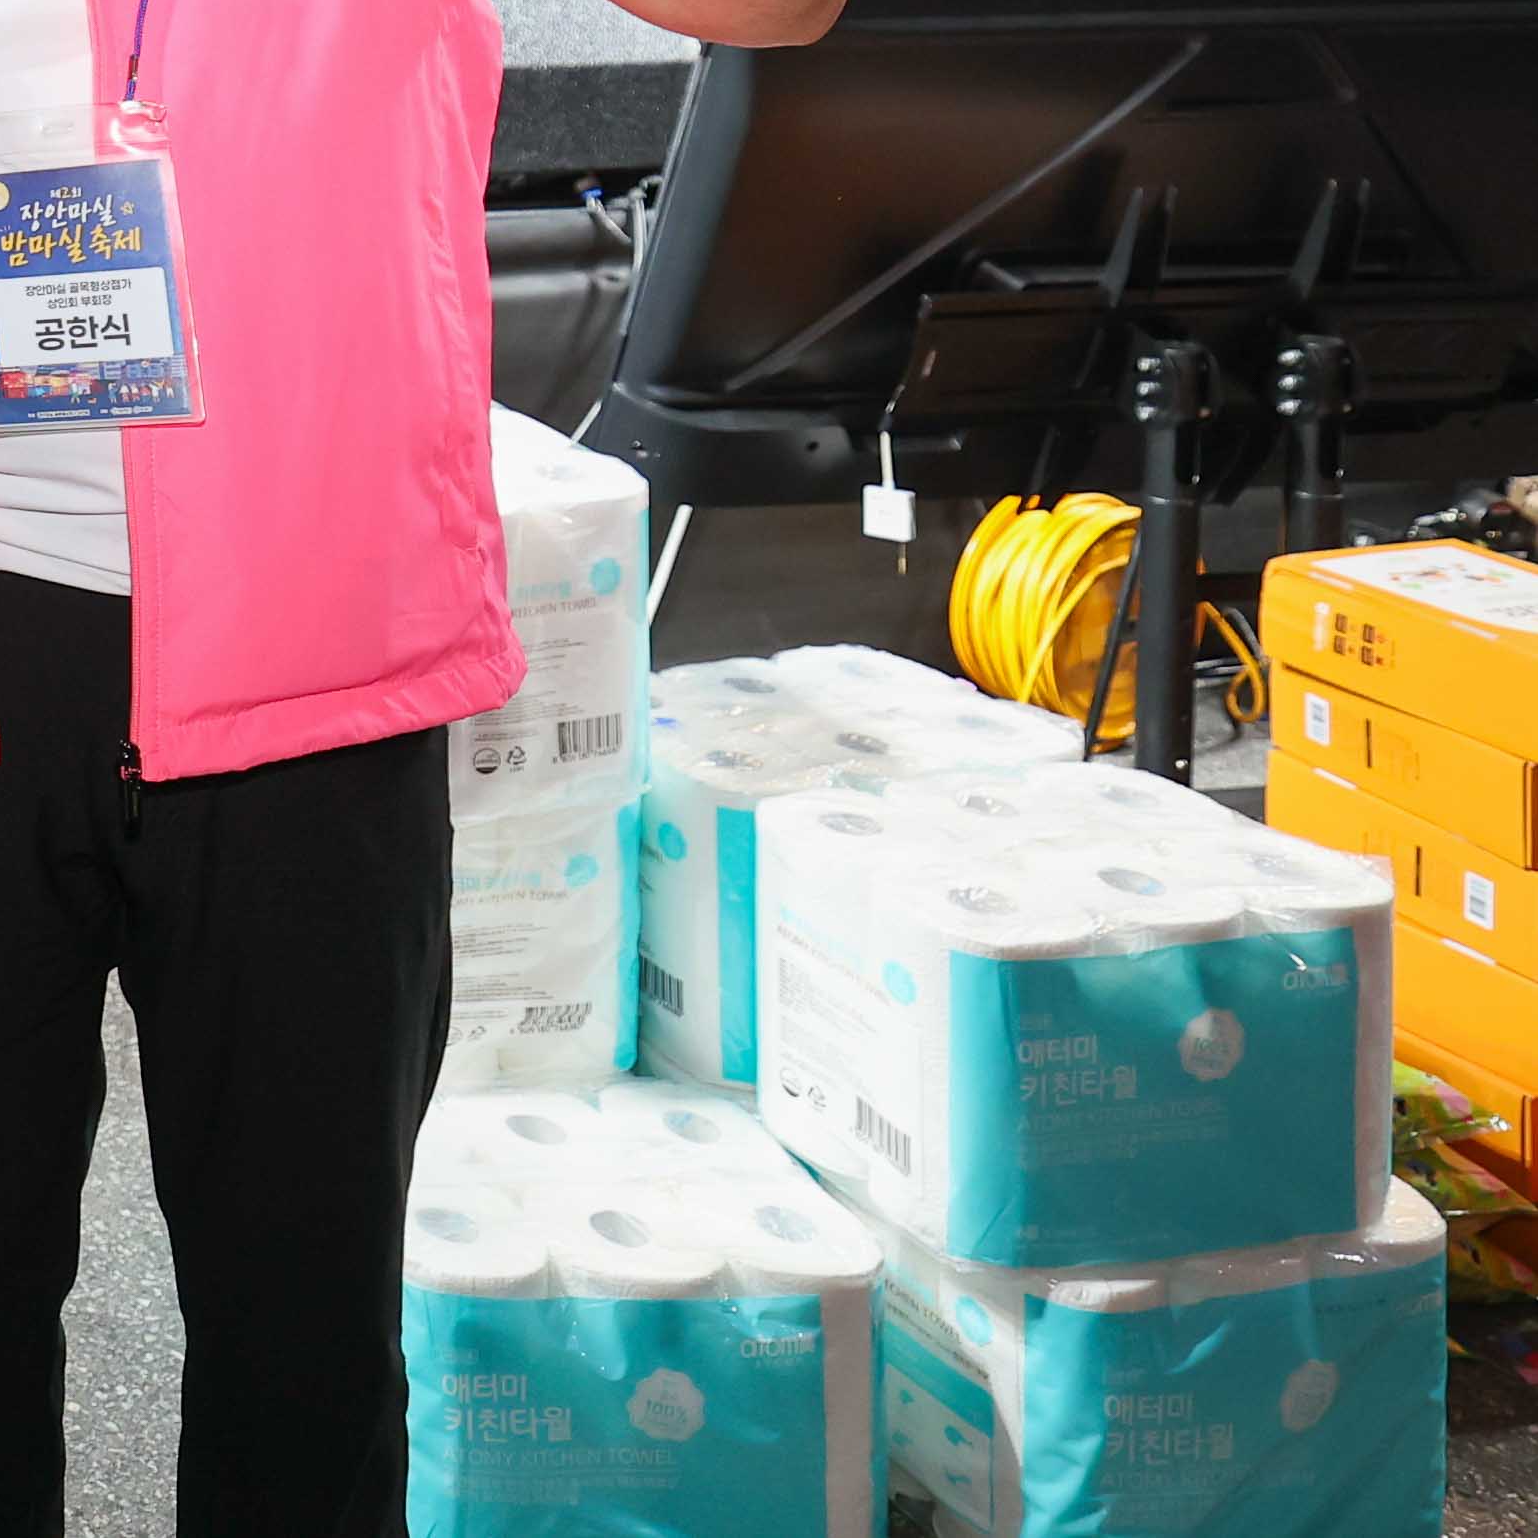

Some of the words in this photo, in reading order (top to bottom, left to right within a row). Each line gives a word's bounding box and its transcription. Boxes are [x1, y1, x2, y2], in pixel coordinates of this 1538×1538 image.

[19, 193, 117, 232] 장안마실
[25, 282, 67, 297] 장안마실
[35, 312, 132, 351] 공한식
[1017, 1033, 1099, 1066] 애터미
[1020, 1064, 1139, 1107] 키친타월
[440, 1373, 528, 1404] 애터미
[444, 1405, 573, 1444] 키친타월
[1104, 1391, 1195, 1423] 애터미
[442, 1447, 514, 1466] ATOMY
[607, 1446, 676, 1465] TOWEL
[1107, 1422, 1234, 1464] 키친타월
